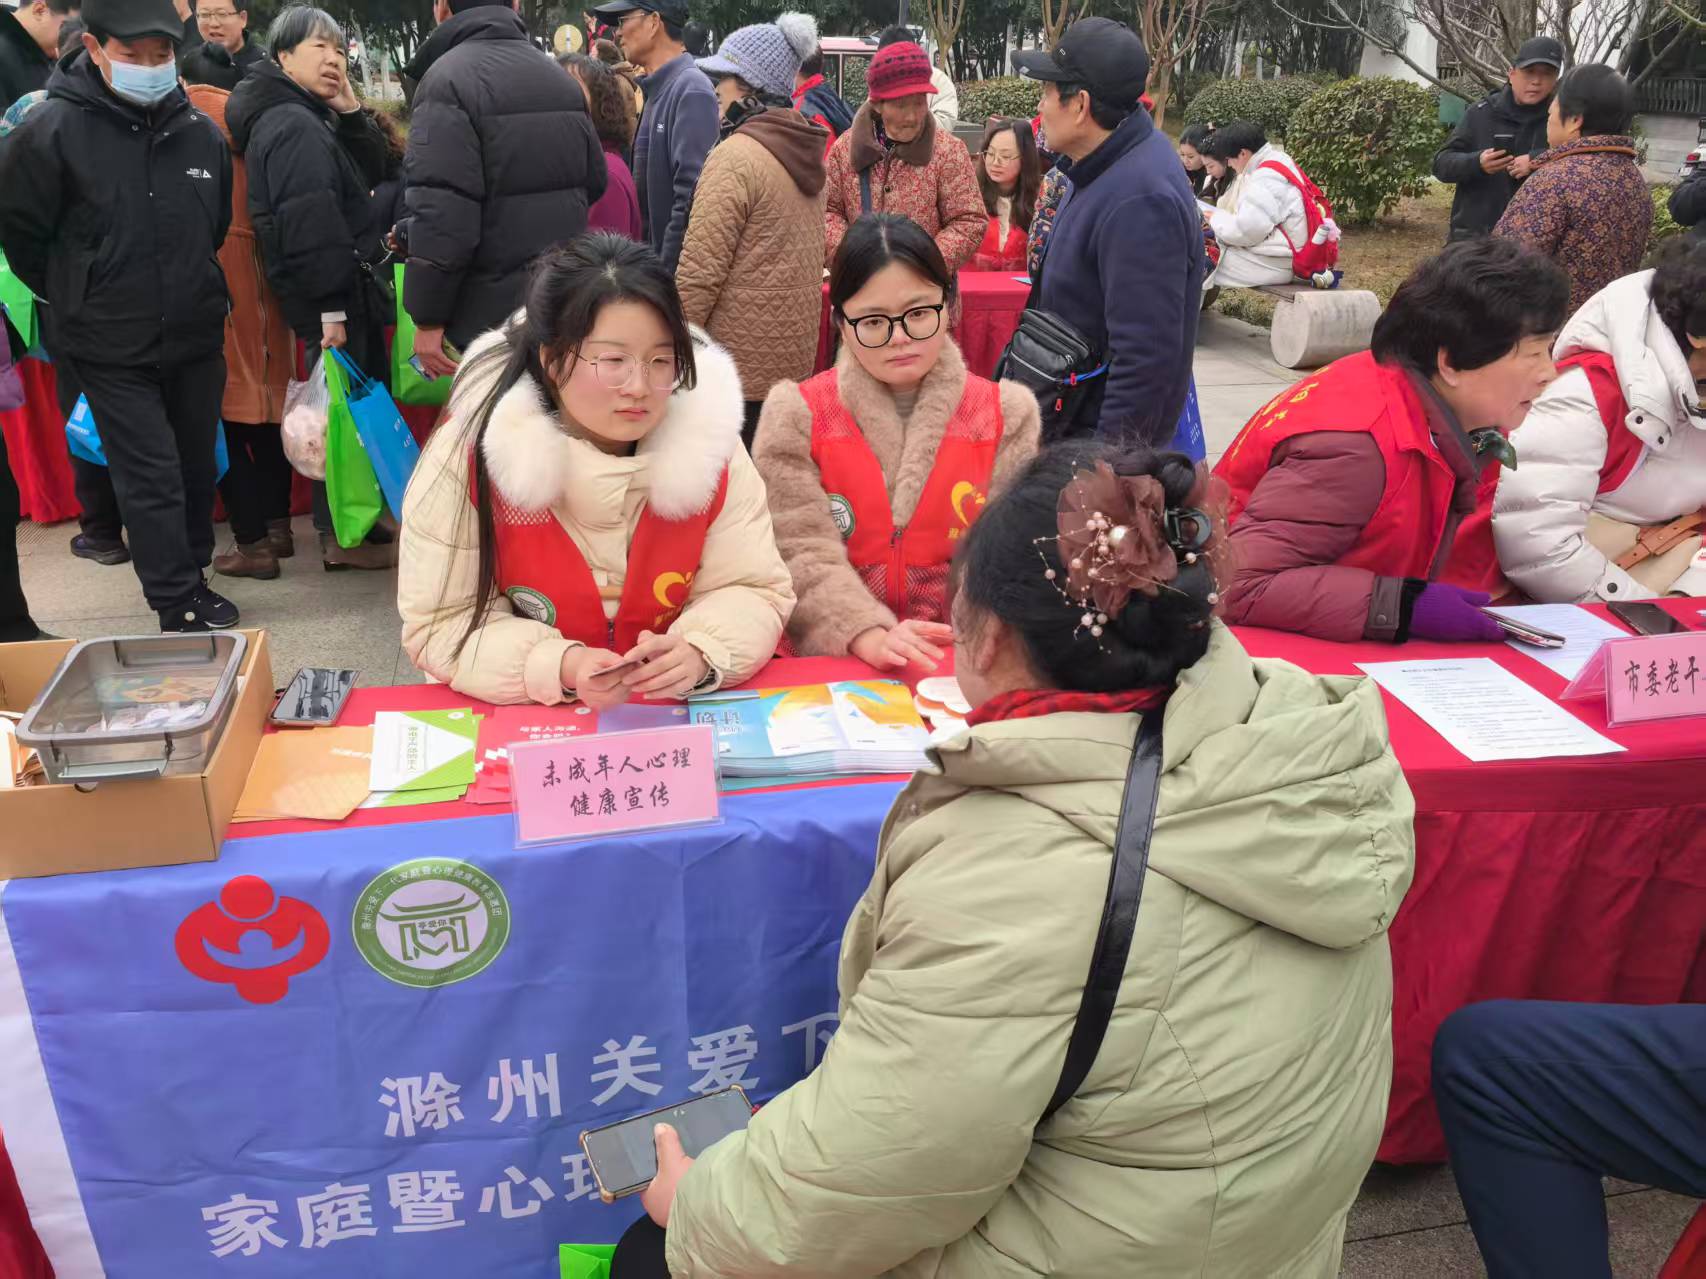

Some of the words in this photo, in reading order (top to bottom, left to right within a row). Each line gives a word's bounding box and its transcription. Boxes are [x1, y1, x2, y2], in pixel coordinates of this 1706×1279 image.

[1624, 655, 1706, 704] 市委老干
[542, 747, 692, 788] 未成年人心理
[570, 781, 671, 817] 健康宣传
